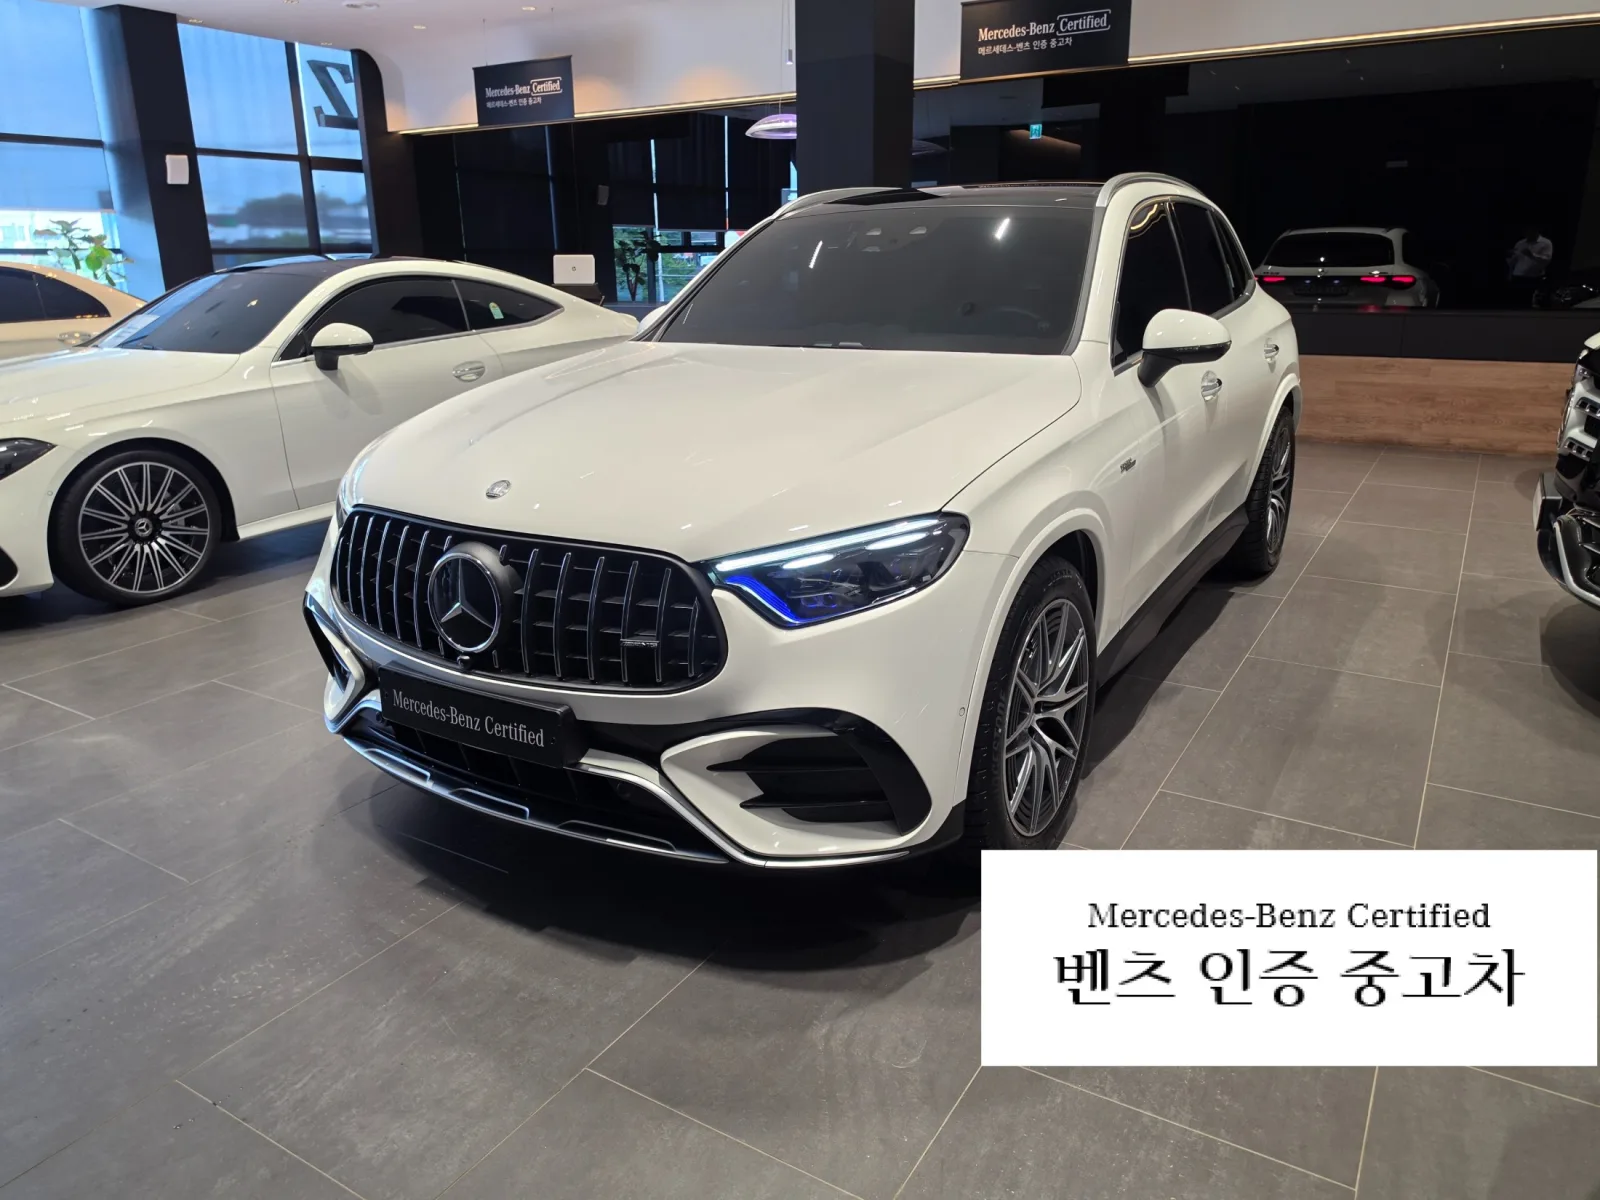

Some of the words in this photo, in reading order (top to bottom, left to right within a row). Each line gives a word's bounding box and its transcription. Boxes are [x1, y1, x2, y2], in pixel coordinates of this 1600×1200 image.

[977, 22, 1055, 42] Mercedes-Benz
[1059, 13, 1108, 32] Certified
[977, 41, 1031, 56] 메르세데스-벤츠
[1032, 39, 1048, 50] 인증
[1049, 37, 1073, 48] 중고차
[485, 84, 530, 98] Mercedes-Benz
[532, 80, 561, 93] Certified
[392, 689, 481, 732] Mercedes-Benz
[484, 716, 545, 747] Certified
